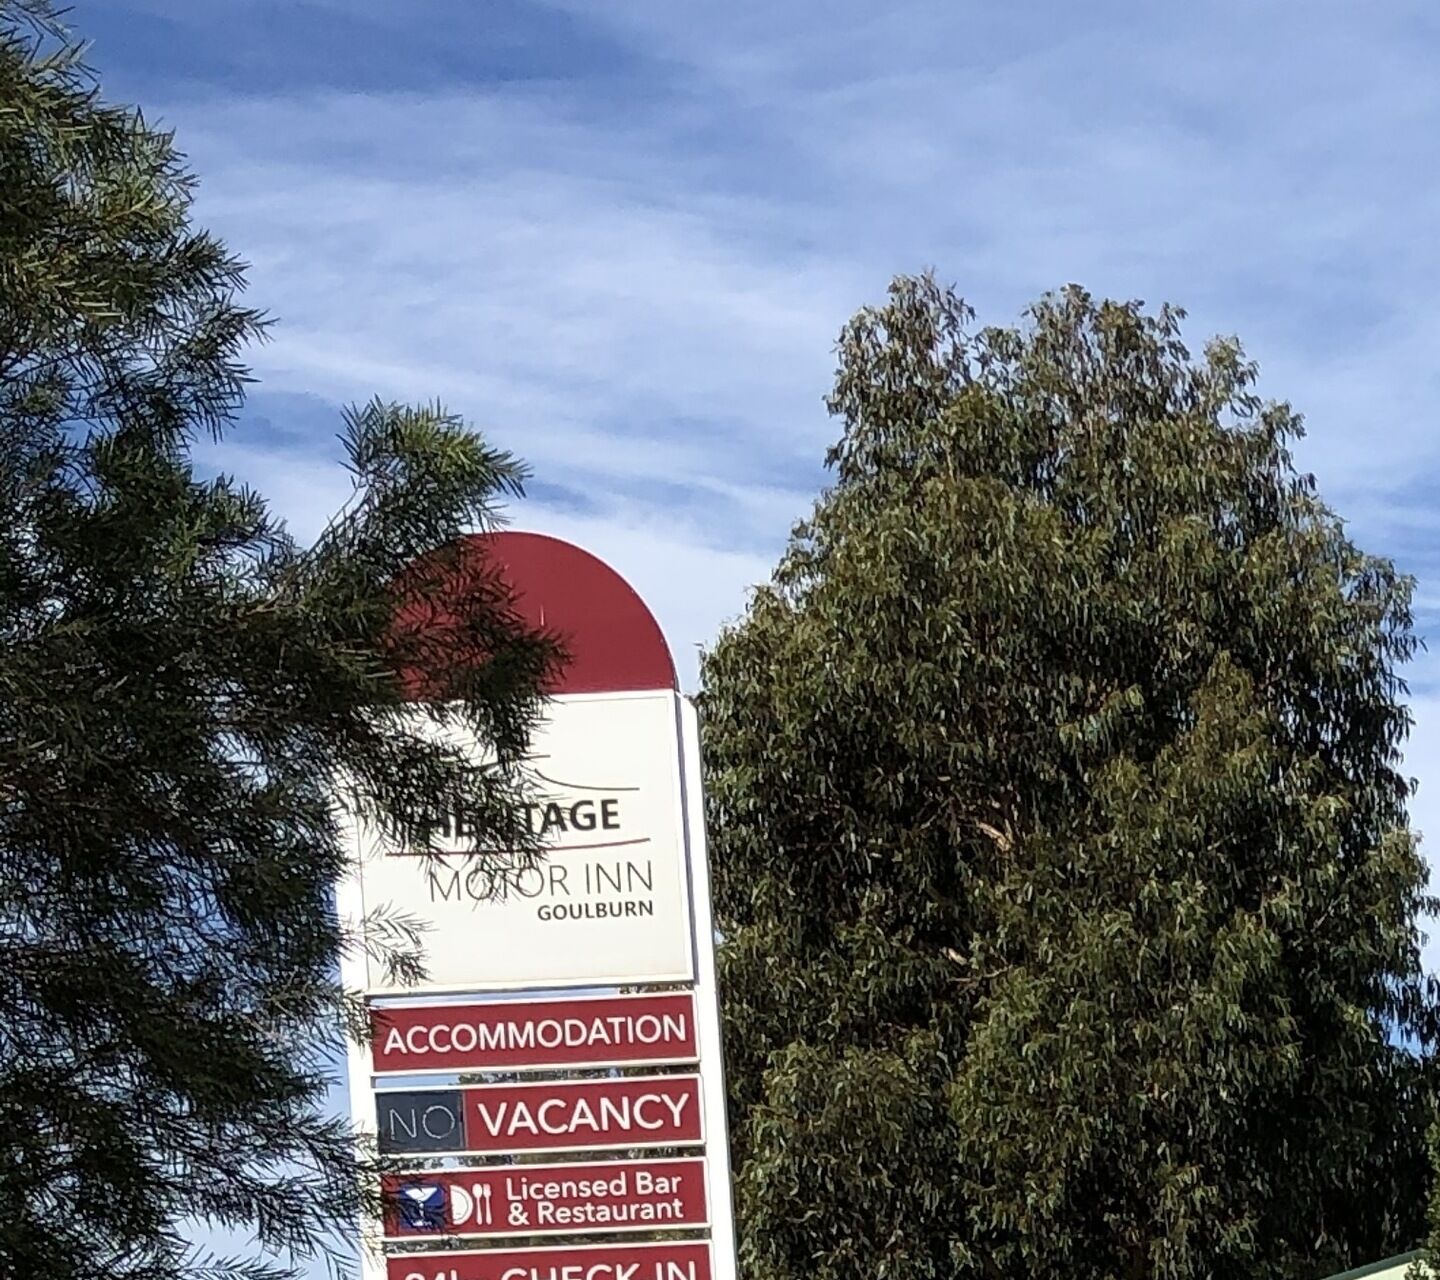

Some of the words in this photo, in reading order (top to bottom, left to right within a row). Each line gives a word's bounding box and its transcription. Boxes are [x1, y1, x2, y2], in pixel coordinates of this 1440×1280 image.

[430, 864, 570, 902] MOTOR
[586, 861, 653, 894] INN
[537, 900, 654, 921] GOULBURN
[383, 1014, 687, 1055] ACCOMMODATION
[389, 1105, 456, 1141] NO
[477, 1093, 690, 1137] VACANCY
[506, 1171, 627, 1201] Licensed
[635, 1171, 682, 1196] Bar
[508, 1203, 530, 1226] &
[537, 1198, 684, 1223] Restaurant
